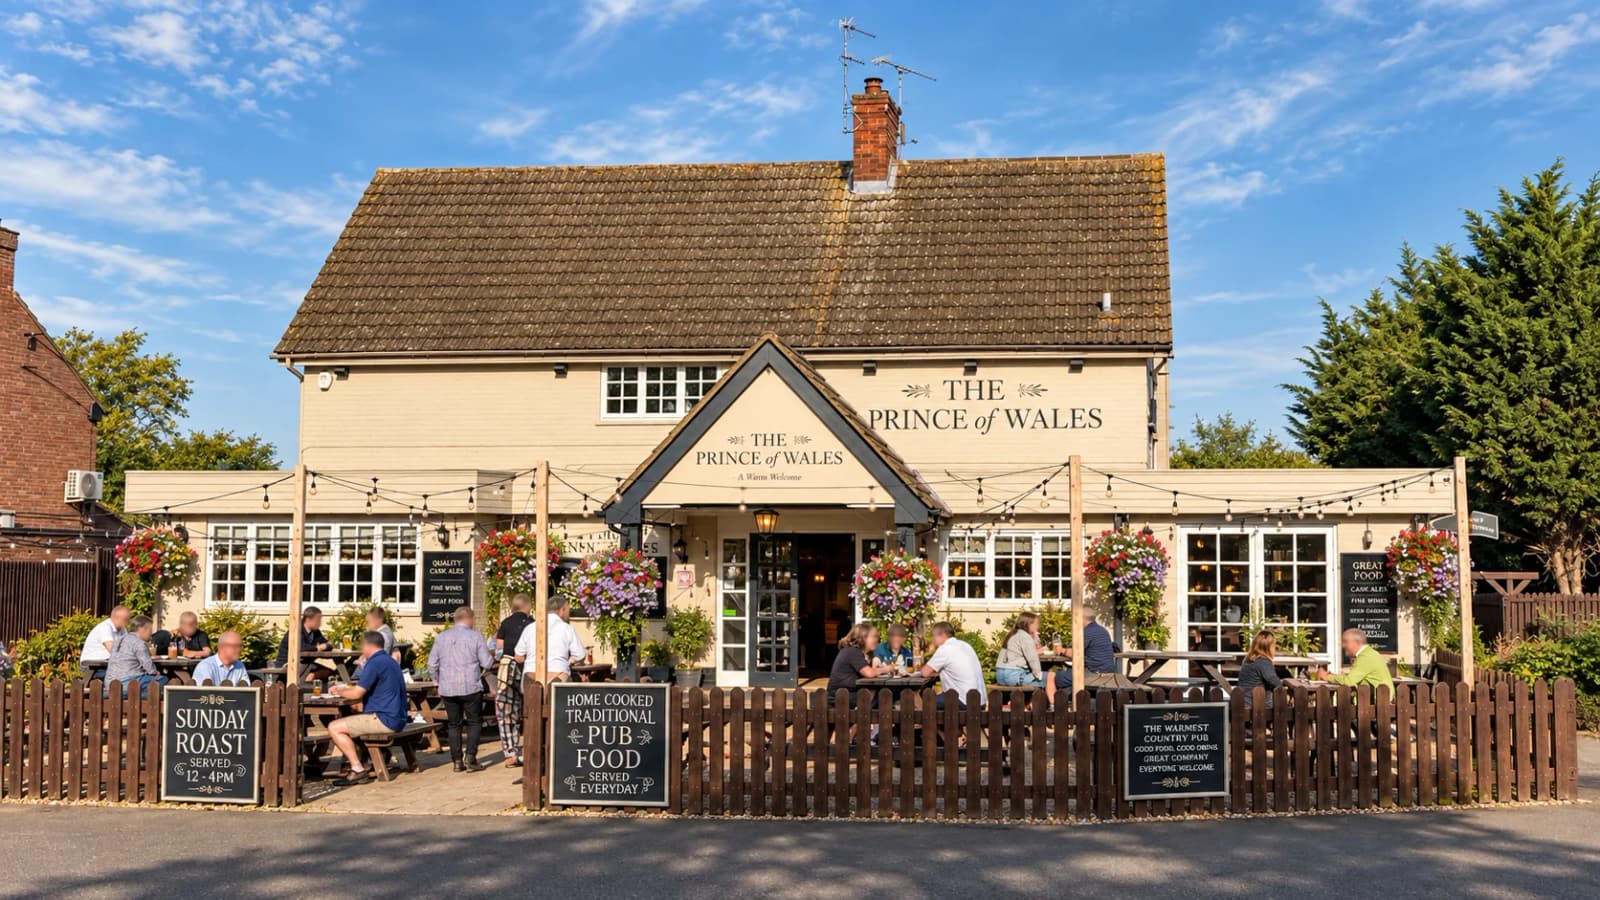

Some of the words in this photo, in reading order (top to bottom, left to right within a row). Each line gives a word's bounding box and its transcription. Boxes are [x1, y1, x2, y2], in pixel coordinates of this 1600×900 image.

[943, 379, 1005, 400] THE
[868, 409, 968, 430] PRINCE
[974, 407, 999, 435] of
[1004, 407, 1103, 430] WALES
[751, 433, 787, 447] THE
[696, 451, 761, 466] PRINCE
[765, 451, 781, 468] of
[783, 451, 843, 466] WALES
[738, 473, 744, 481] A
[770, 473, 802, 481] Welcome
[1352, 561, 1384, 570] GREAT
[1354, 571, 1384, 580] FOOD
[567, 694, 601, 707] HOME
[604, 693, 653, 707] COOKED
[175, 708, 249, 730] SUNDAY
[565, 708, 656, 724] TRADITIONAL
[588, 725, 633, 745] PUB
[1143, 725, 1162, 733] THE
[1164, 724, 1209, 732] WARMEST
[175, 732, 248, 755] ROAST
[1143, 734, 1188, 743] COUNTRY
[1191, 734, 1209, 742] PUB
[190, 757, 231, 768] SERVED
[576, 749, 641, 768] FOOD
[1139, 765, 1177, 773] EVERYONE
[1178, 764, 1215, 772] WELCOME
[186, 770, 199, 782] 12
[208, 771, 234, 783] 4PM
[589, 772, 630, 782] SERVED
[580, 783, 639, 794] EVERYDAY
